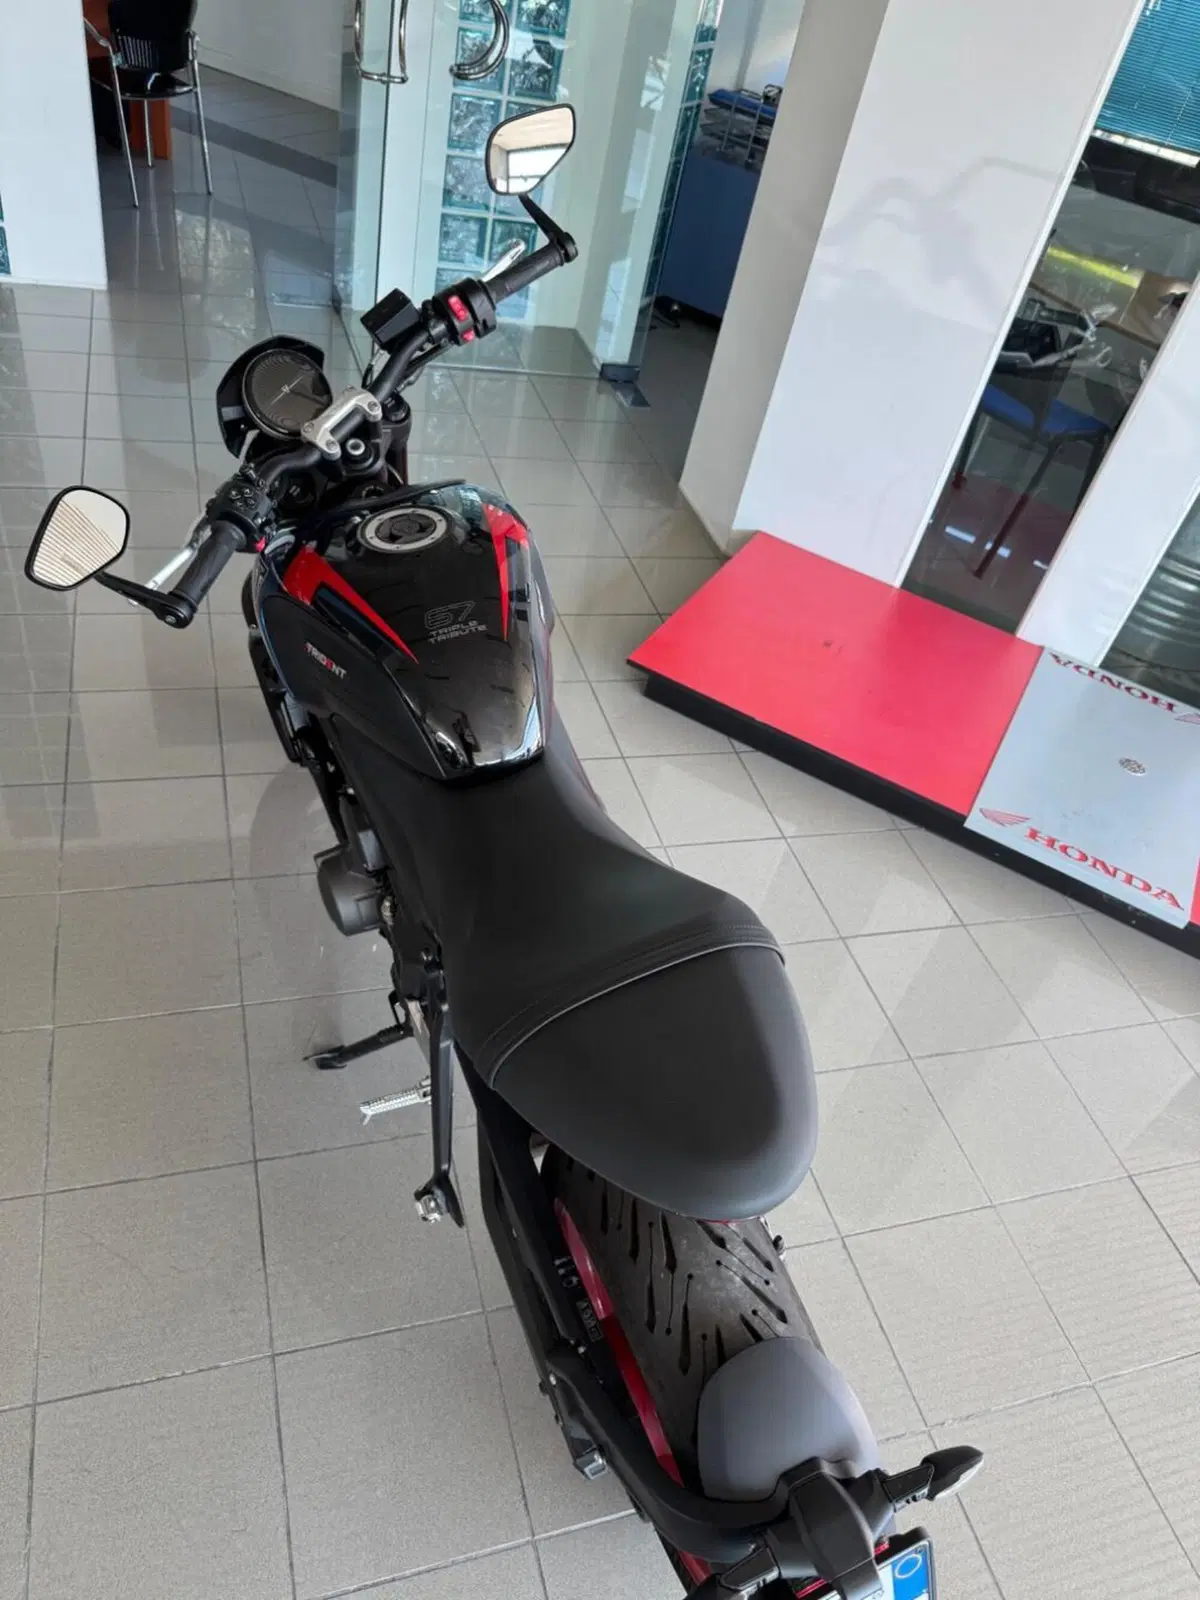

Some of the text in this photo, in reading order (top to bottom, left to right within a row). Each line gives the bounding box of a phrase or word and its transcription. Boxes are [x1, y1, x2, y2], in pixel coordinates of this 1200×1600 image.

[428, 620, 478, 637] TRIPLE
[428, 624, 488, 644] TRIBUTE
[305, 641, 348, 680] TRIDENT
[1048, 651, 1177, 713] HONDA
[1024, 826, 1185, 911] HONDA
